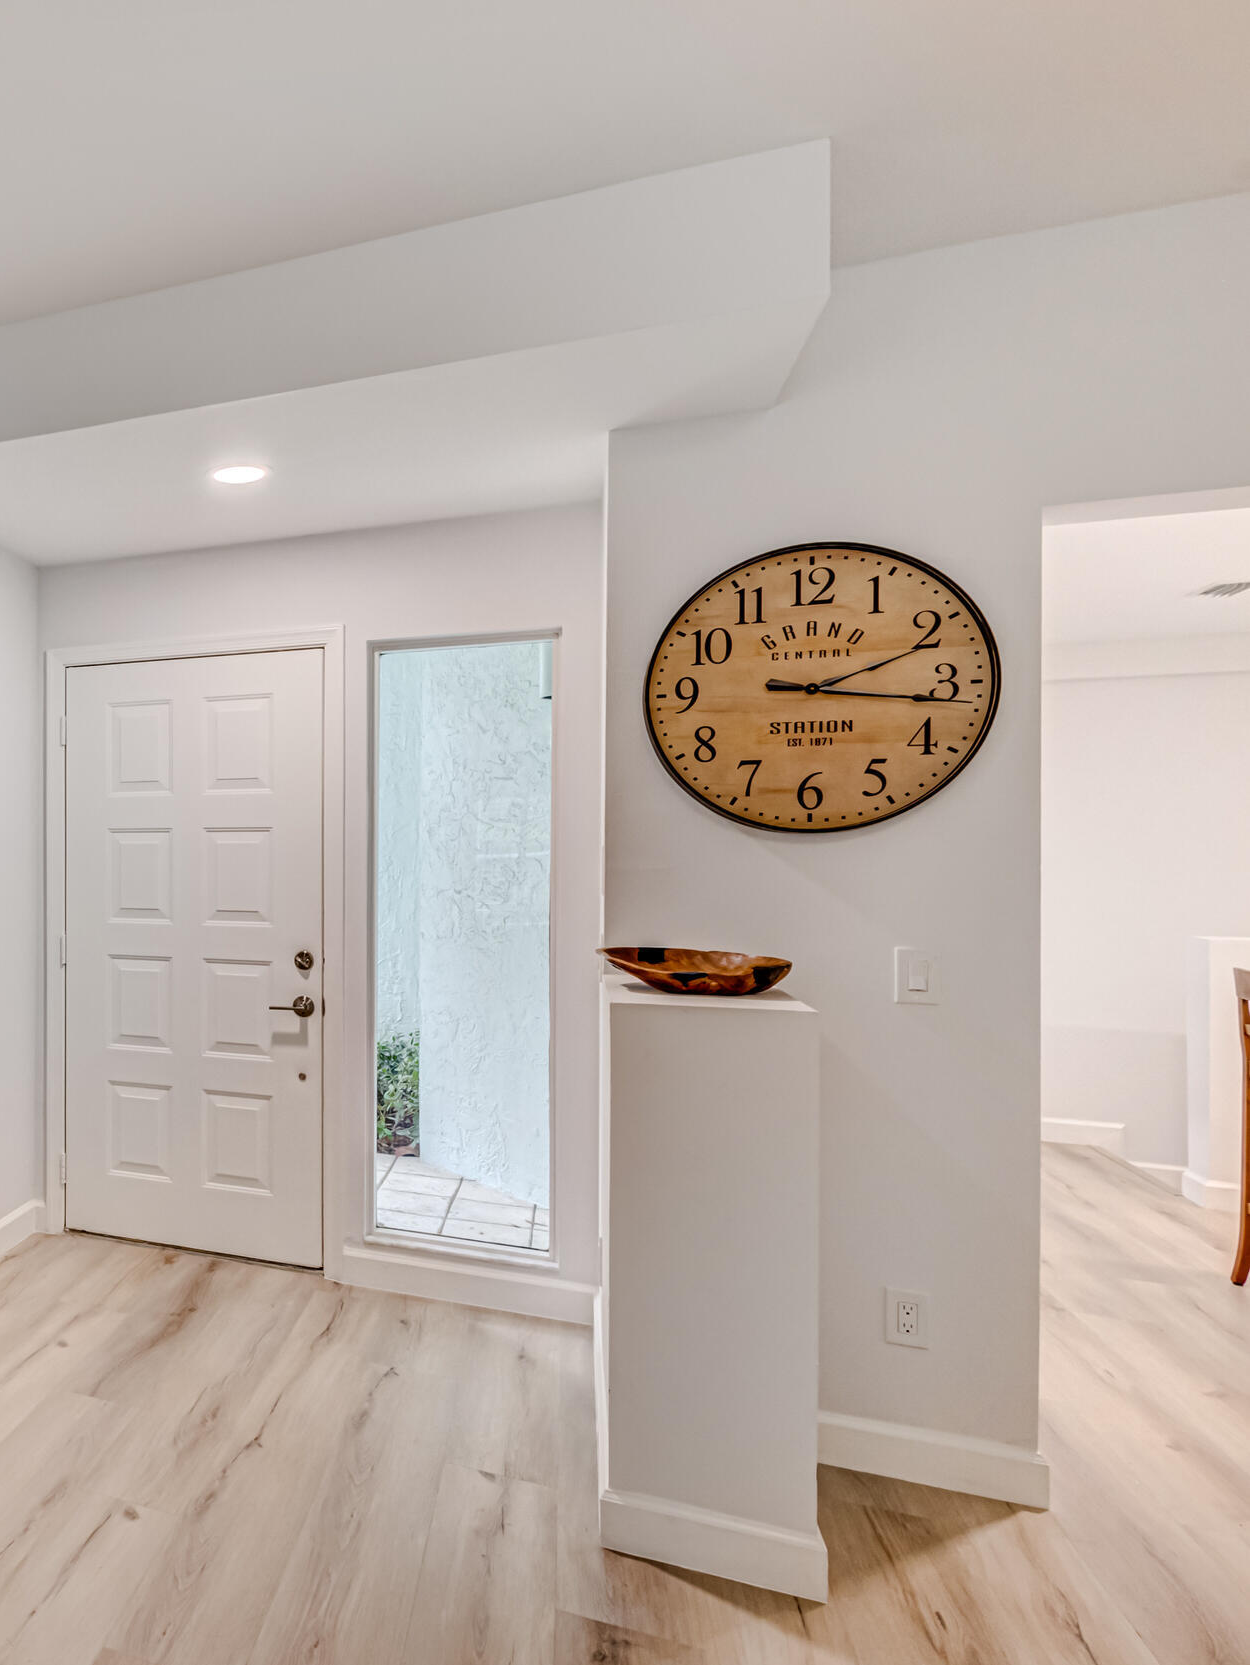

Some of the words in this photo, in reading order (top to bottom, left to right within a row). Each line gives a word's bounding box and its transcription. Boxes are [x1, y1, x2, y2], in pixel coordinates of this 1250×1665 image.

[734, 586, 767, 625] 11
[790, 566, 836, 607] 12
[867, 575, 885, 614] 1
[690, 627, 732, 666] 10
[760, 620, 865, 651] GRAND
[911, 609, 942, 650] 2
[771, 648, 852, 661] CENTRAL
[674, 676, 699, 714] 9
[929, 662, 960, 701] 3
[693, 726, 716, 762] 8
[769, 719, 854, 734] STATION
[787, 738, 806, 747] EST.
[810, 737, 833, 746] 1871
[907, 717, 938, 755] 4
[736, 760, 762, 797] 7
[796, 772, 823, 810] 6
[862, 758, 887, 797] 5
